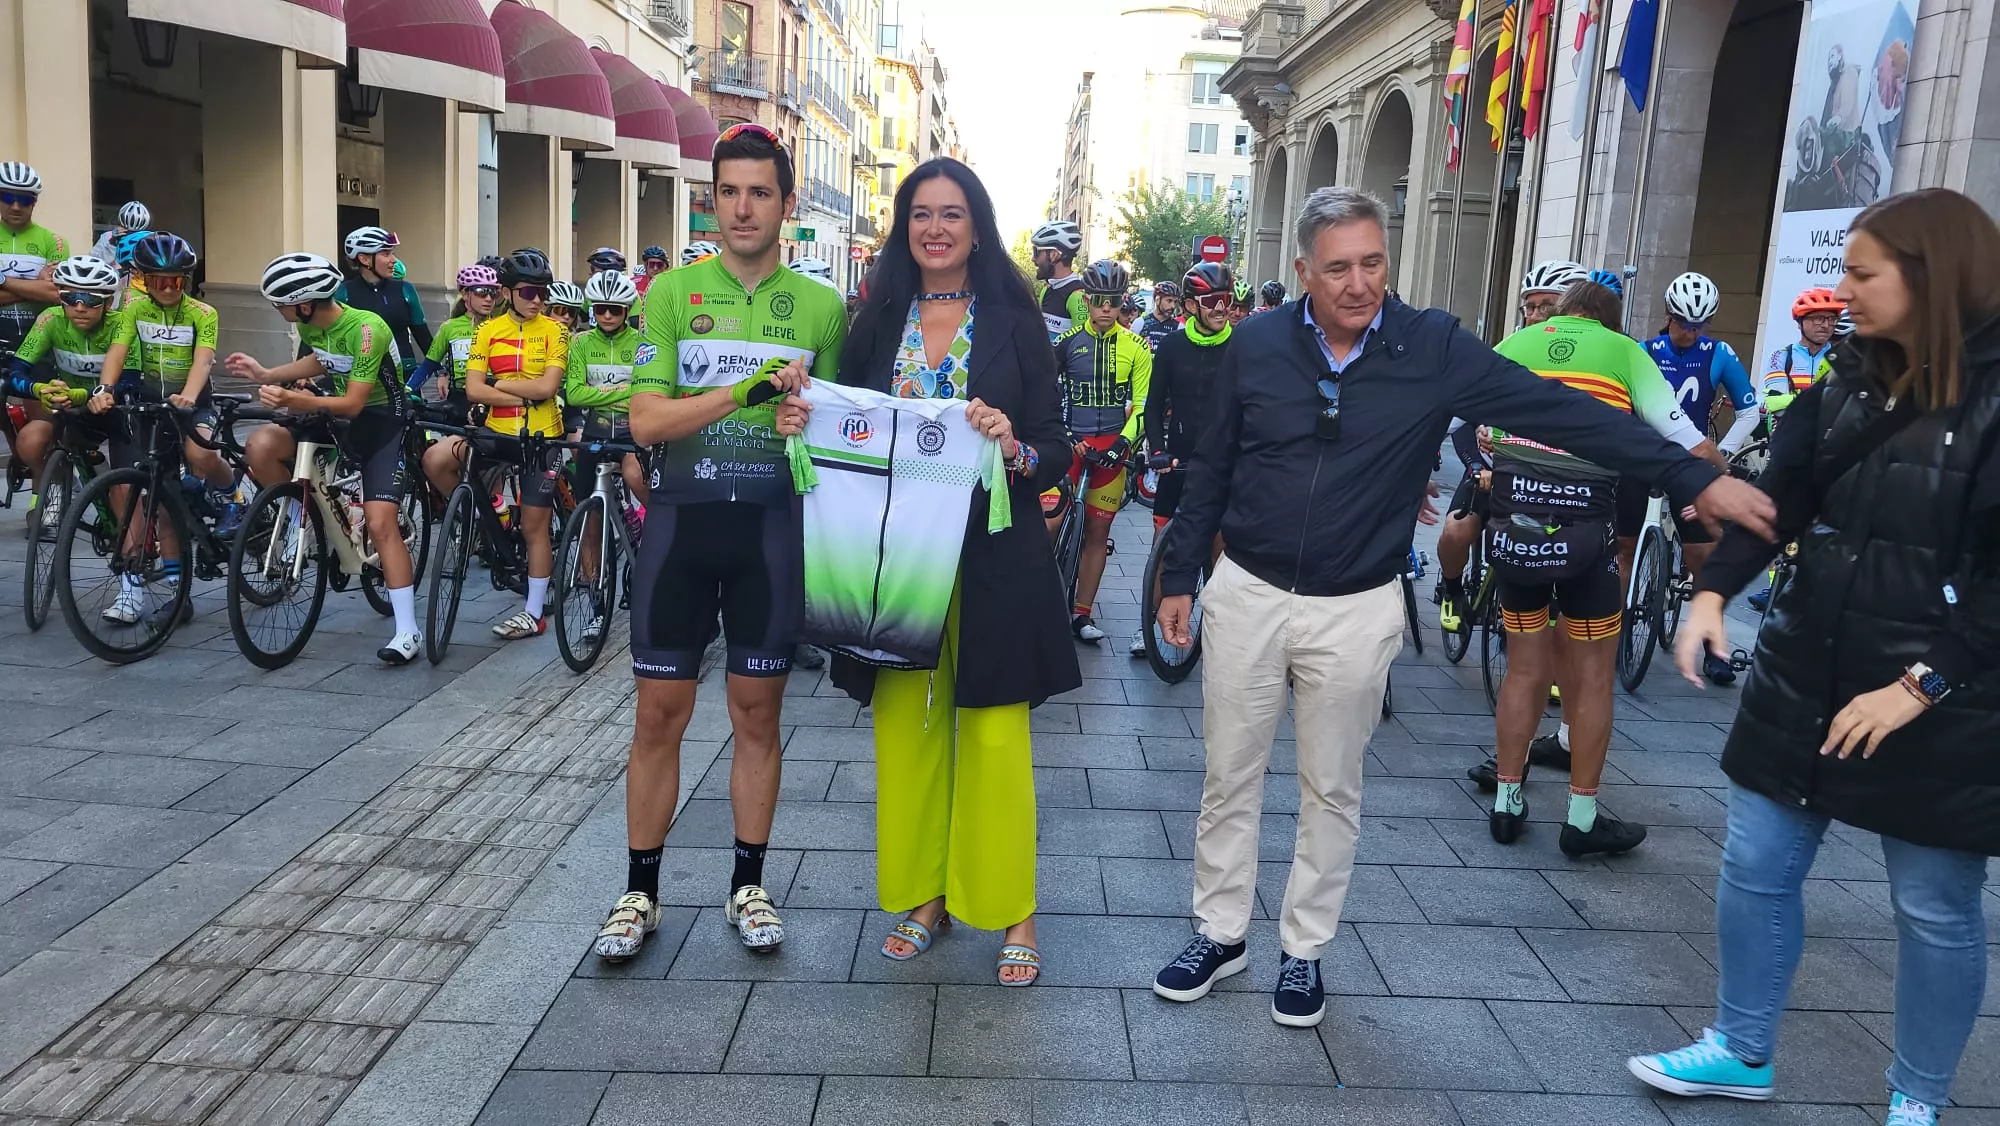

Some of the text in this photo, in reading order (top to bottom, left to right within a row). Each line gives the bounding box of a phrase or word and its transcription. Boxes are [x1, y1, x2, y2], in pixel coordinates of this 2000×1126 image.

[1810, 229, 1846, 247] VIAJE
[717, 366, 744, 375] AUTO
[700, 417, 772, 440] uesca
[844, 418, 868, 434] 60
[748, 462, 776, 473] PÉREZ
[1512, 475, 1591, 498] Huesca
[1493, 531, 1569, 557] Huesca
[1525, 558, 1567, 567] oscense
